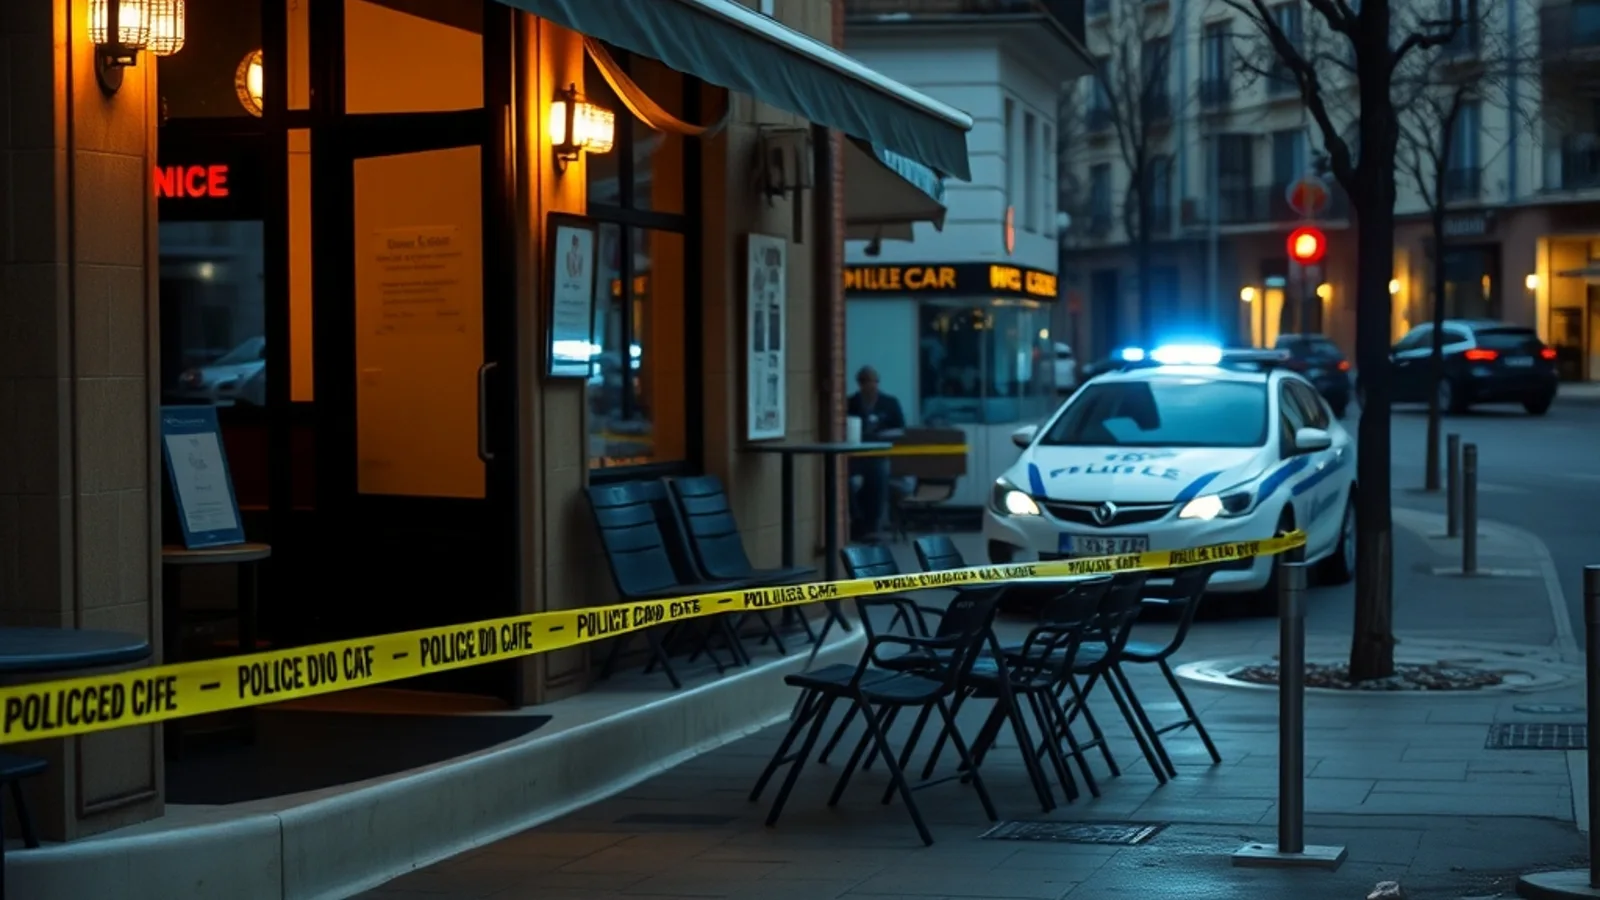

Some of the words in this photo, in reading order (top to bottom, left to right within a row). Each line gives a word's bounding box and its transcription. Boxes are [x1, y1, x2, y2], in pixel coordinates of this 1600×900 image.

[155, 165, 229, 198] NICE
[904, 267, 956, 290] CAR
[3, 683, 125, 734] POLICCED
[238, 658, 305, 699] POLICE
